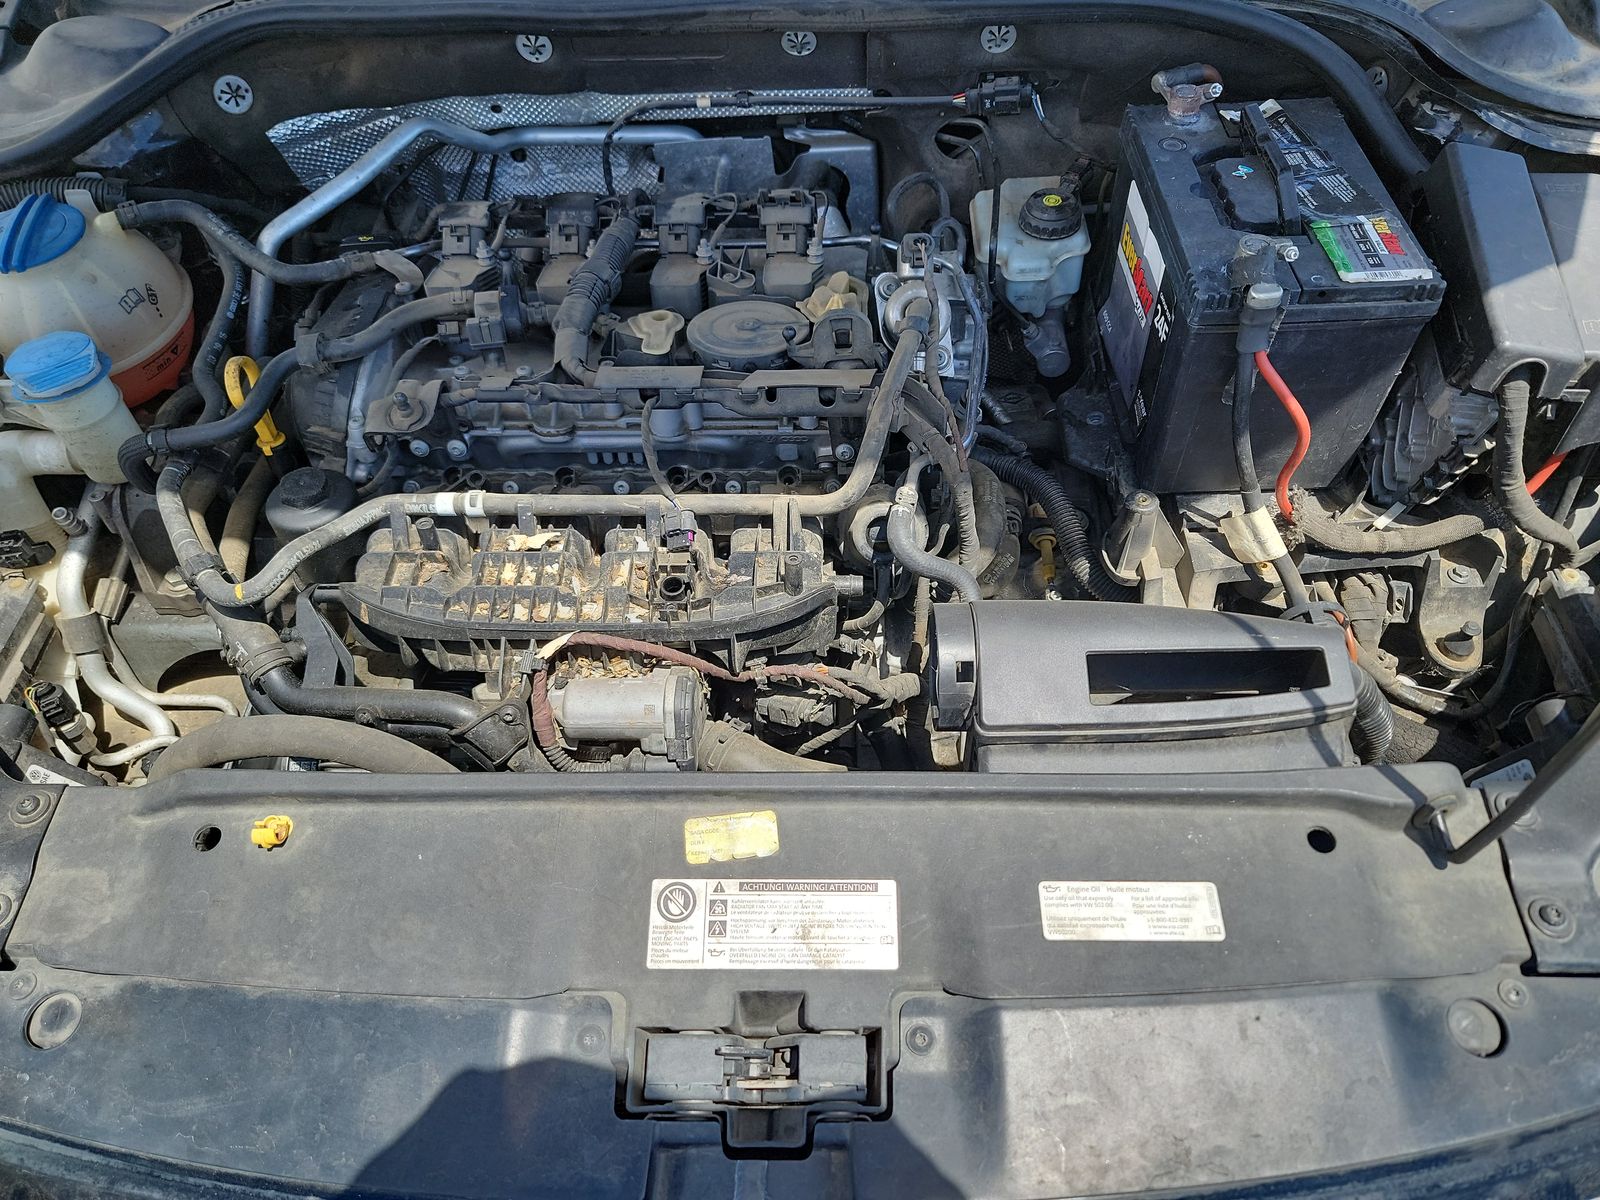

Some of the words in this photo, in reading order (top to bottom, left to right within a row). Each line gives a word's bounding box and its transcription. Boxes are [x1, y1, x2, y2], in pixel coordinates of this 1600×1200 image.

[1121, 222, 1153, 316] EverStart
[1153, 303, 1169, 343] 24F
[156, 356, 172, 372] min
[39, 770, 51, 784] SAE
[742, 883, 784, 891] ACHTUNG!
[786, 883, 828, 891] WARNING!
[829, 883, 875, 891] ATTENTION!
[1067, 886, 1090, 894] Engine
